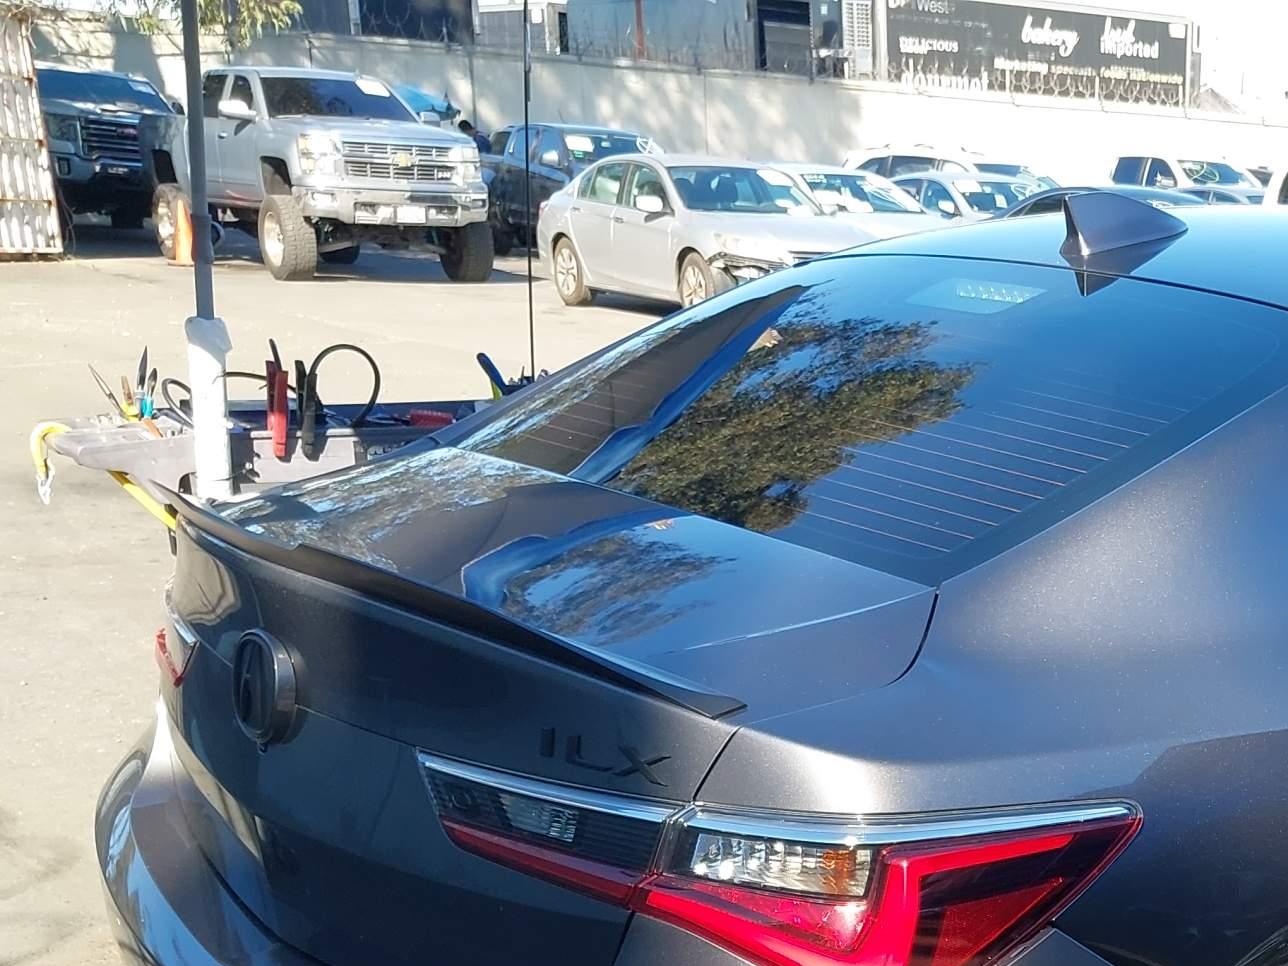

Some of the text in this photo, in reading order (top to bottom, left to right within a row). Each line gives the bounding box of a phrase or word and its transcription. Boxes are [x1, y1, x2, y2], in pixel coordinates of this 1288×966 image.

[899, 36, 959, 53] DELICIOUS
[1021, 15, 1080, 57] bakery
[1101, 39, 1159, 59] imported
[540, 727, 672, 788] ILX
